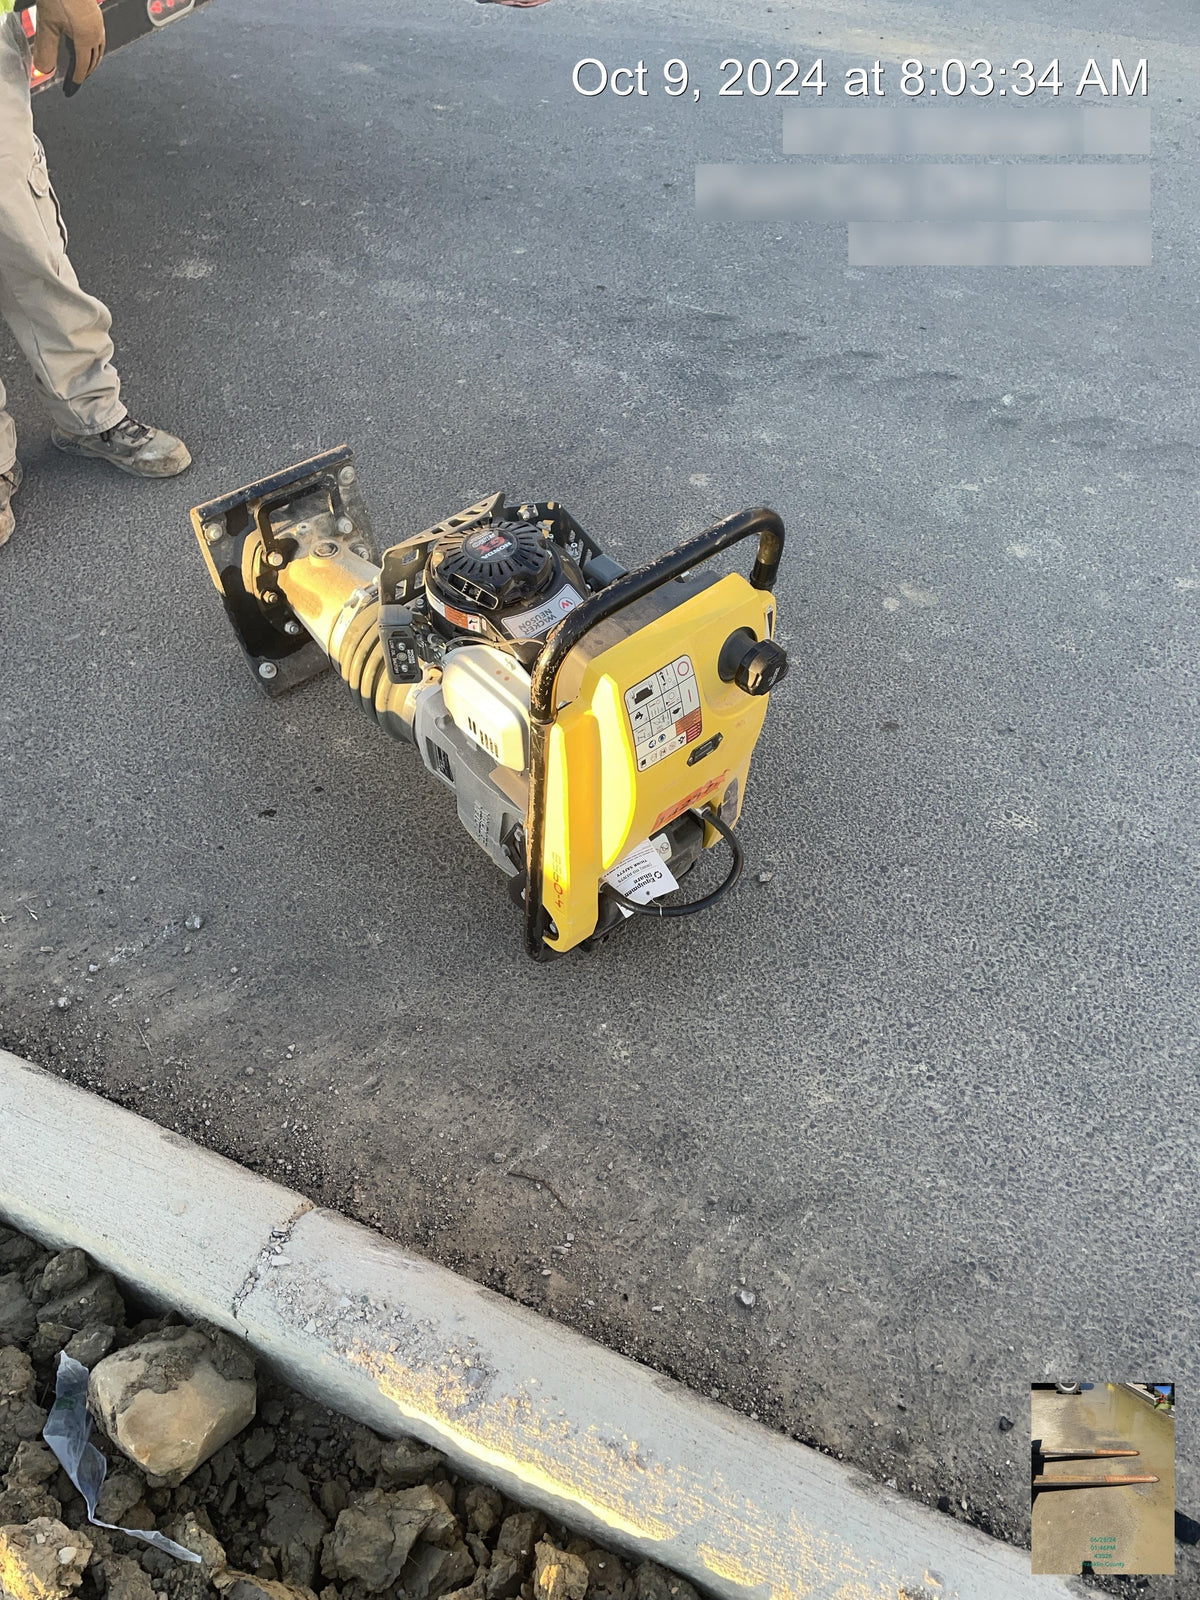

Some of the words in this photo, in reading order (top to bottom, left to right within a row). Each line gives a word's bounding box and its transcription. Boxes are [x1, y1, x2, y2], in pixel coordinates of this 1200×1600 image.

[480, 541, 512, 559] HONDA
[518, 608, 553, 631] NEUSON
[523, 613, 557, 635] WACKER
[624, 877, 656, 897] Equipmen
[634, 872, 652, 884] Share
